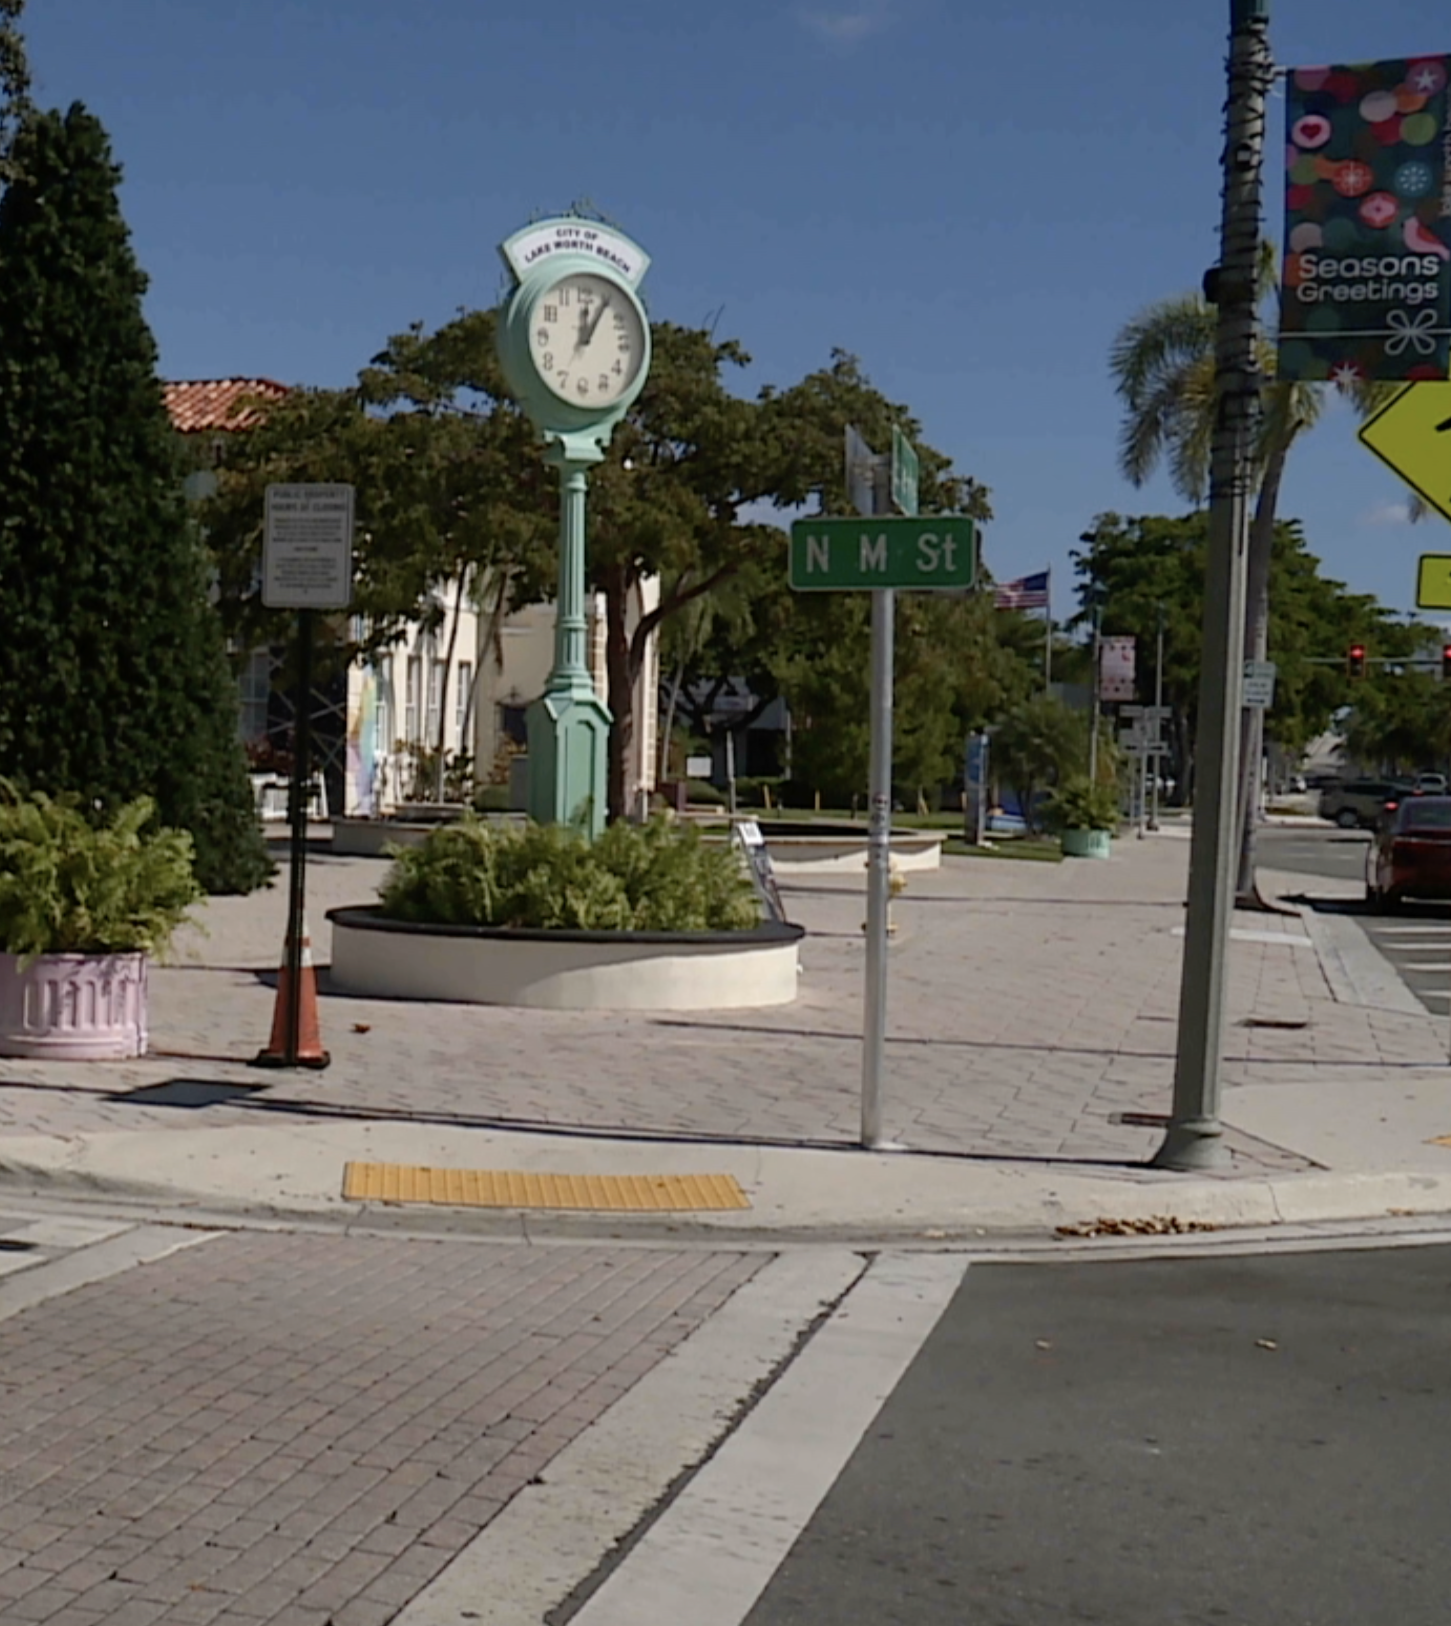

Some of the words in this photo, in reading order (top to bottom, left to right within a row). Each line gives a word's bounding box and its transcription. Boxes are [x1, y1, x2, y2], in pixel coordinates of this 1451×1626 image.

[556, 228, 580, 238] CITY
[584, 230, 597, 240] OF
[525, 243, 550, 262] LAKE
[554, 240, 593, 252] WORTH
[596, 246, 630, 273] BEACH
[1299, 254, 1440, 277] Seasons
[1298, 278, 1439, 305] Greetings
[806, 534, 829, 573] N
[860, 534, 888, 573] M
[916, 534, 956, 573] St
